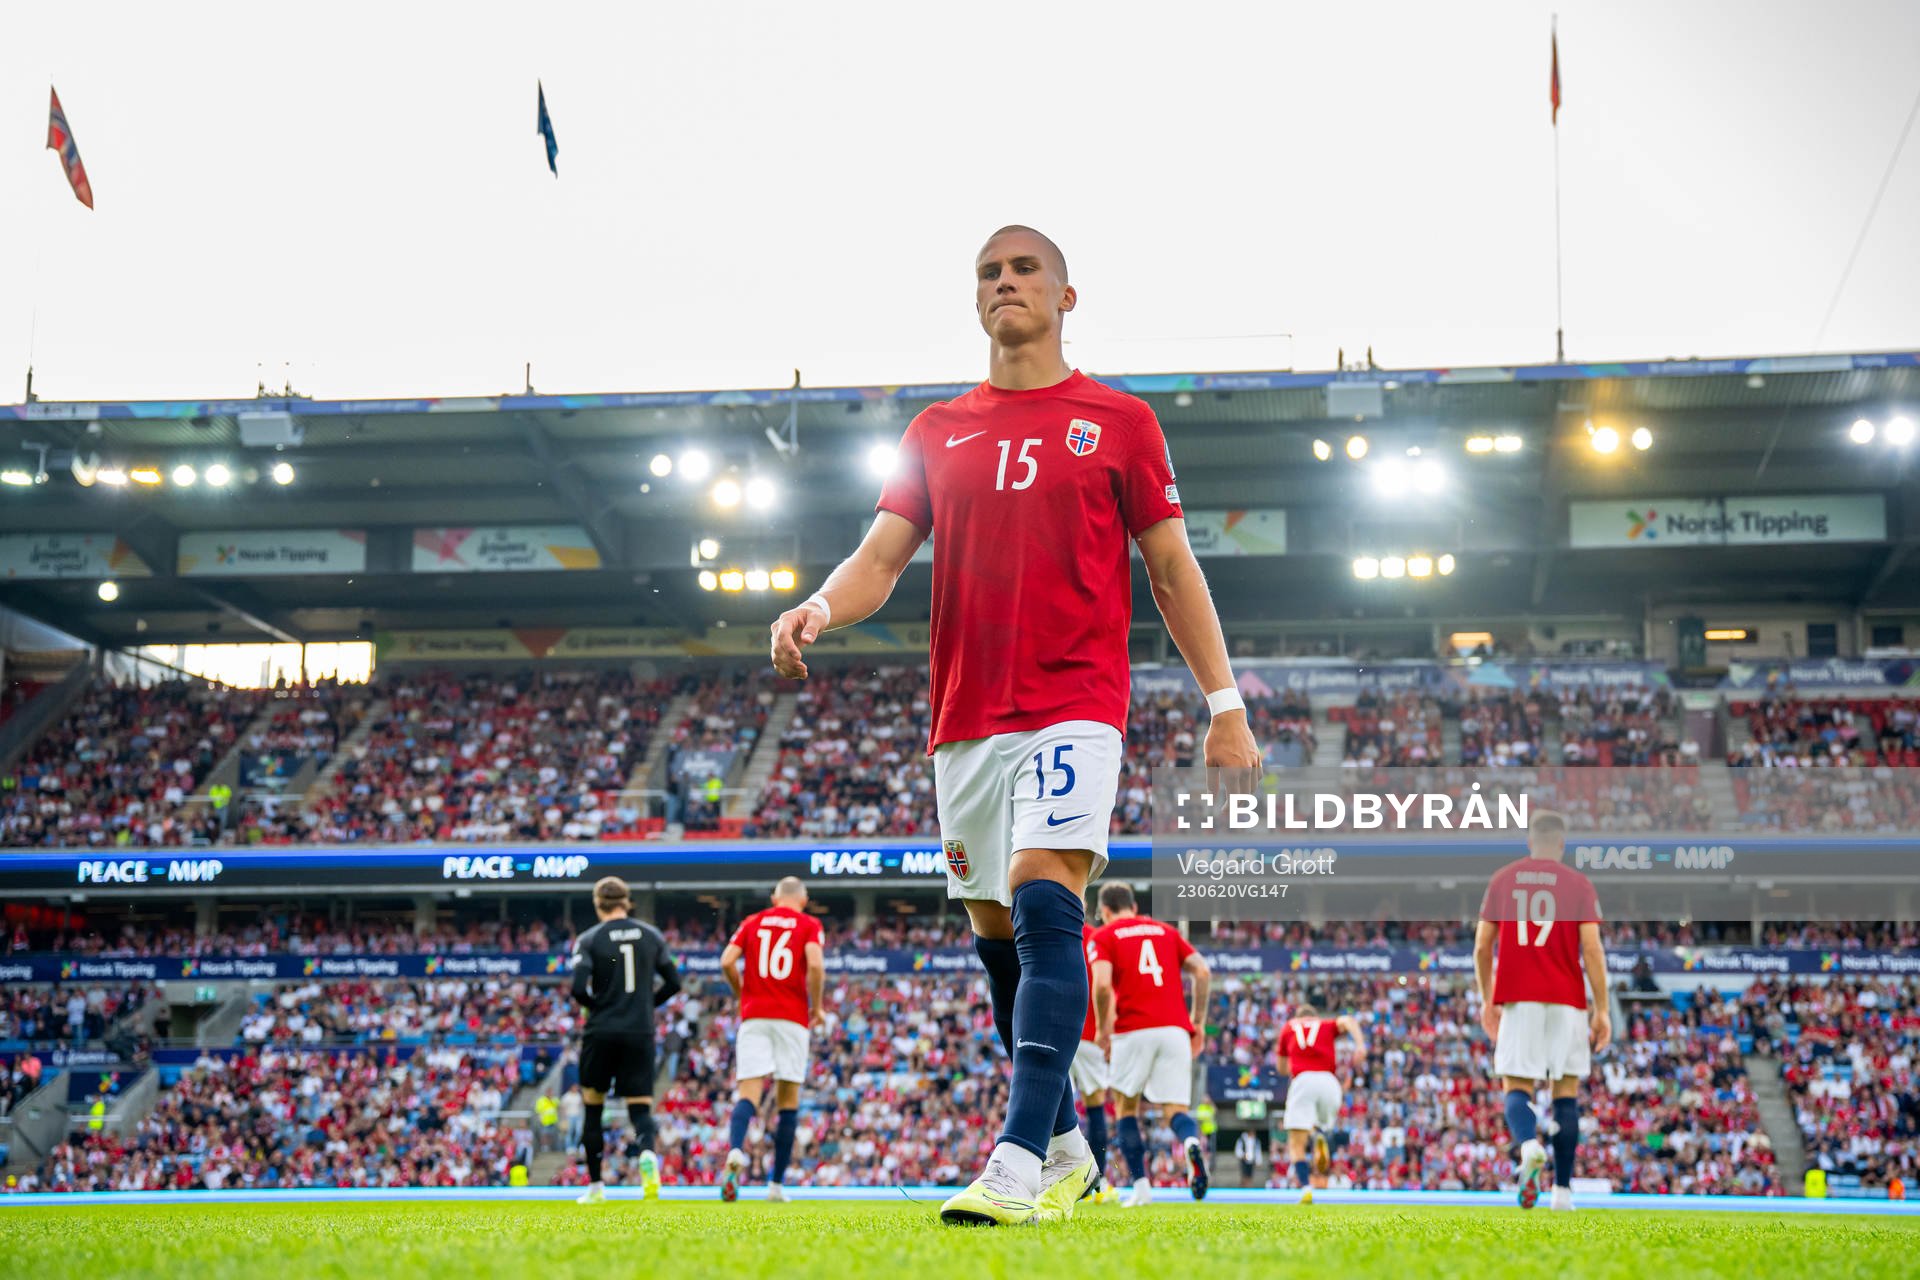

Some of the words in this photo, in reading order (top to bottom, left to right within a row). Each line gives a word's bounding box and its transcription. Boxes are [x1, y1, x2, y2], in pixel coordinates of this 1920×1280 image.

[996, 438, 1042, 491] 15
[1666, 512, 1736, 535] Norsk
[1738, 508, 1829, 537] Tipping
[1034, 744, 1076, 799] 15
[78, 860, 149, 883] PEACE
[443, 856, 515, 879] PEACE
[810, 851, 883, 875] PEACE
[901, 851, 947, 874] МИ
[1575, 845, 1653, 870] PEACE
[1511, 888, 1556, 947] 19
[619, 943, 636, 994] 1
[757, 928, 794, 981] 16
[1138, 938, 1164, 987] 4
[1289, 1018, 1321, 1050] 17
